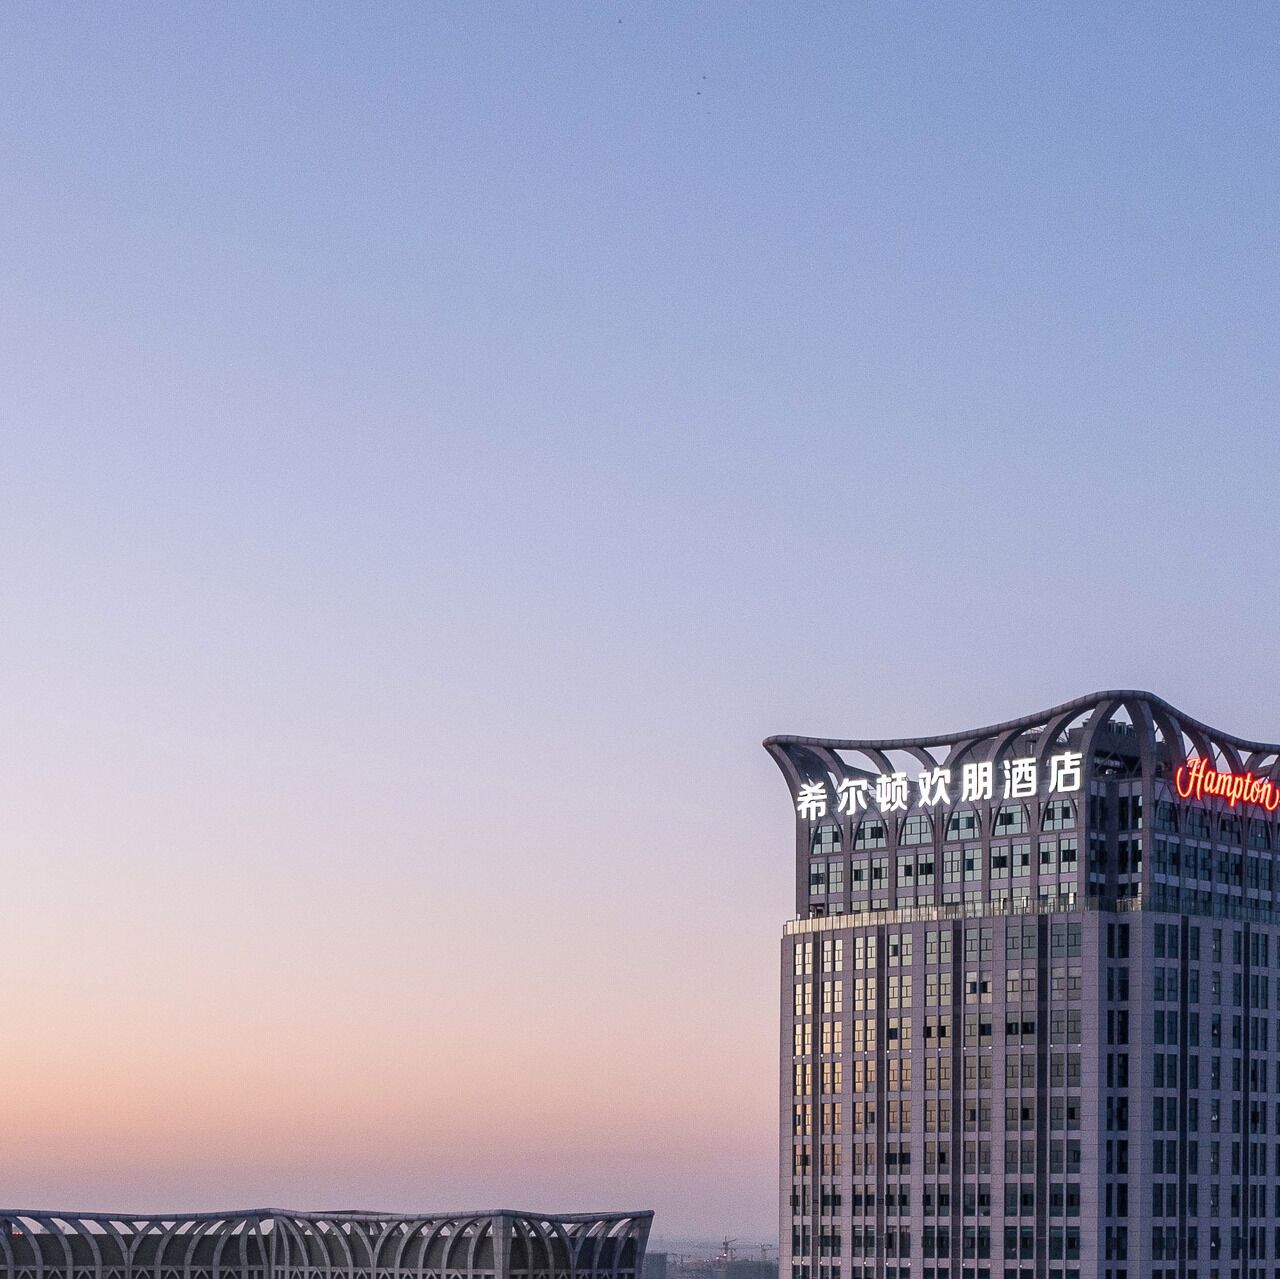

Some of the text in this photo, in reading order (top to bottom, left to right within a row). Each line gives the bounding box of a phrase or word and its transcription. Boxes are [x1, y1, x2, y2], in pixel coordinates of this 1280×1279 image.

[796, 751, 1083, 821] 希尔顿欢朋酒店
[1176, 756, 1280, 812] Hampton
